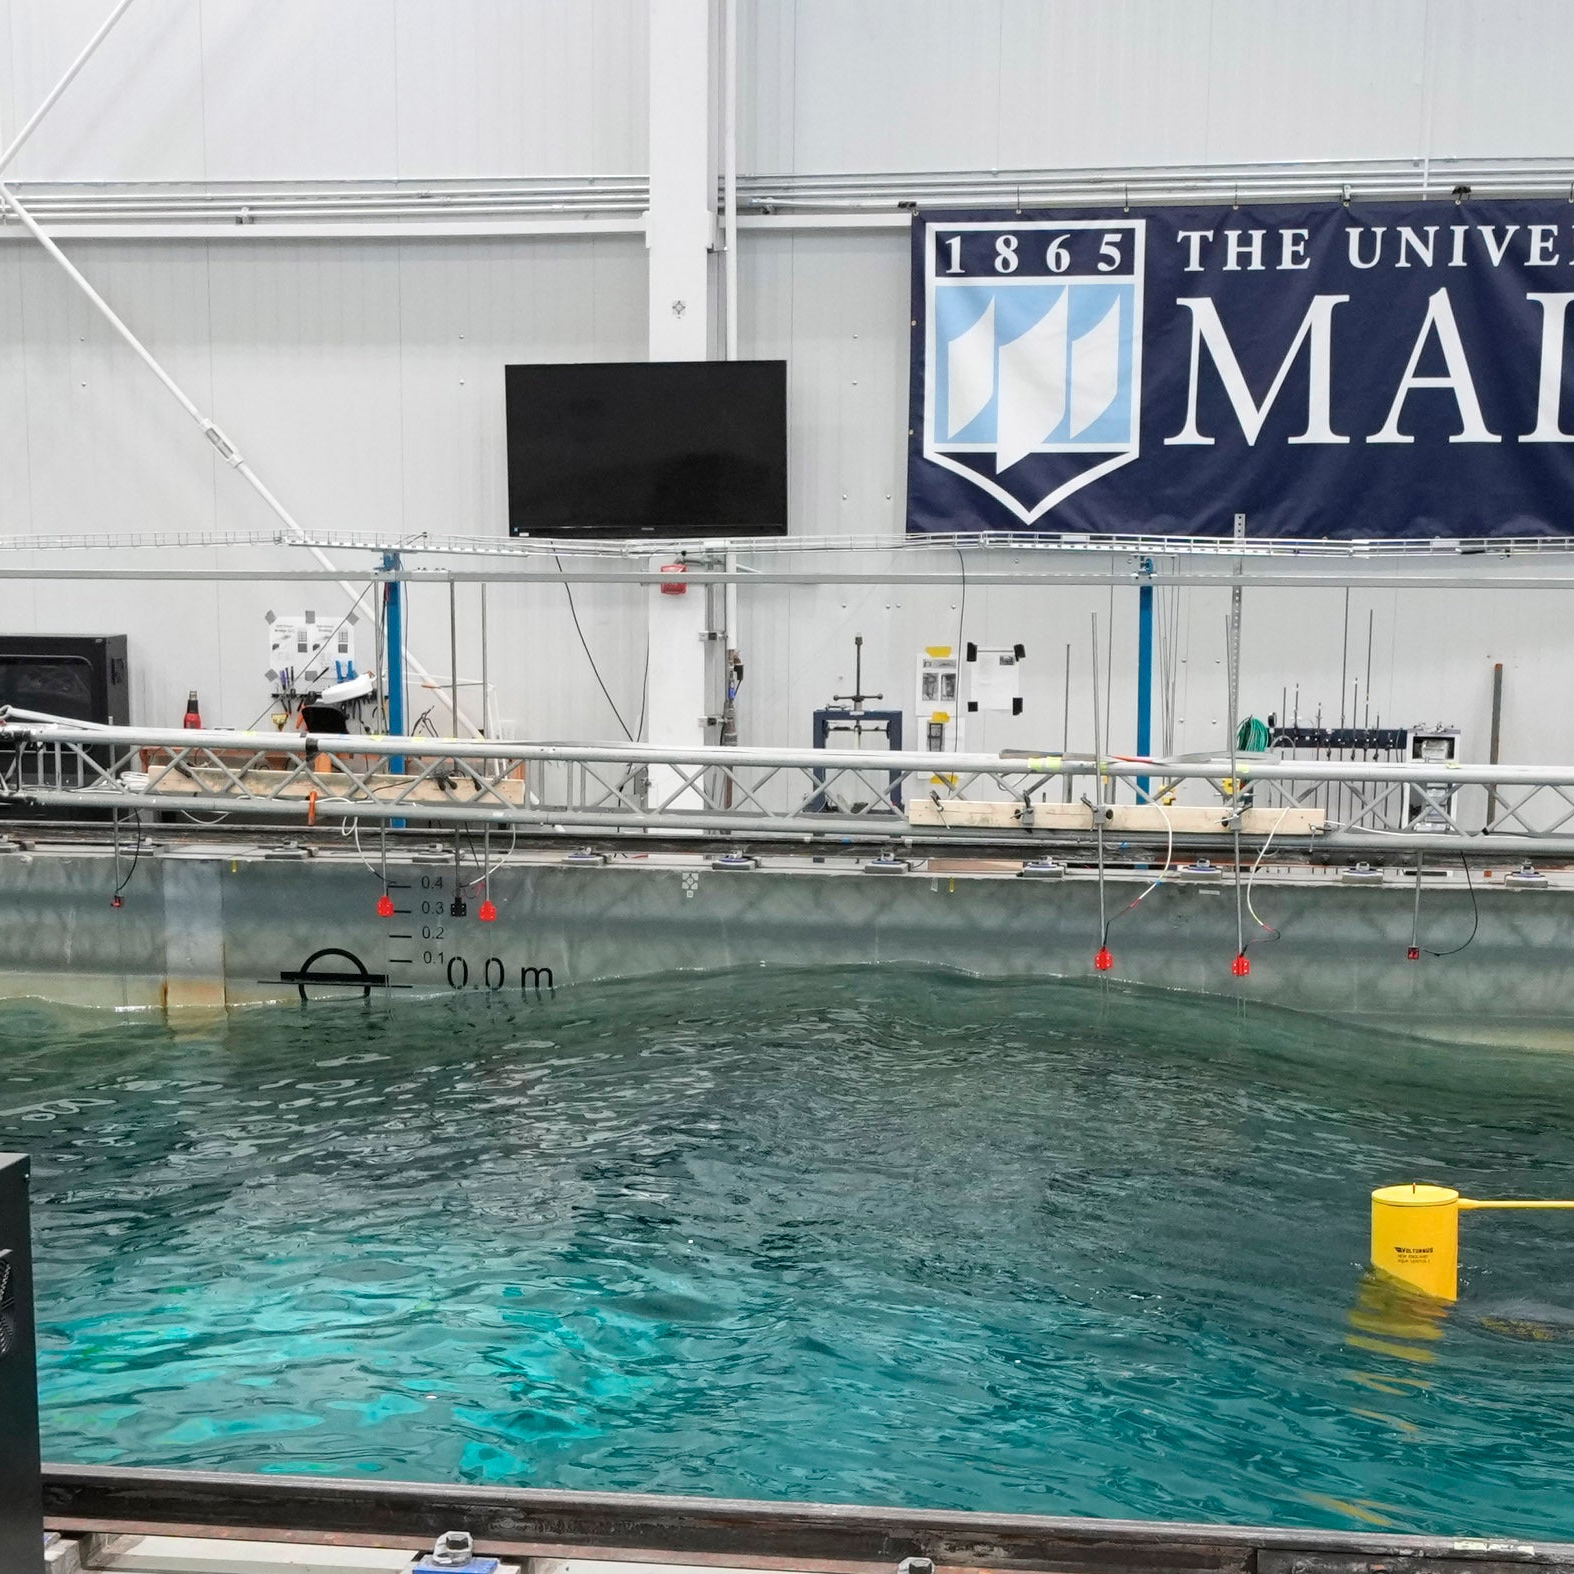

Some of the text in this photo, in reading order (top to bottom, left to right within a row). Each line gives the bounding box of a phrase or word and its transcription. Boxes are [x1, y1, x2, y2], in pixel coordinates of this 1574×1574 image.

[945, 233, 1123, 274] 1865
[1176, 227, 1311, 272] THE
[421, 876, 443, 890] 0.4
[421, 901, 444, 915] 0.3
[421, 926, 445, 940] 0.2
[423, 951, 445, 965] 0.1
[521, 966, 553, 990] m
